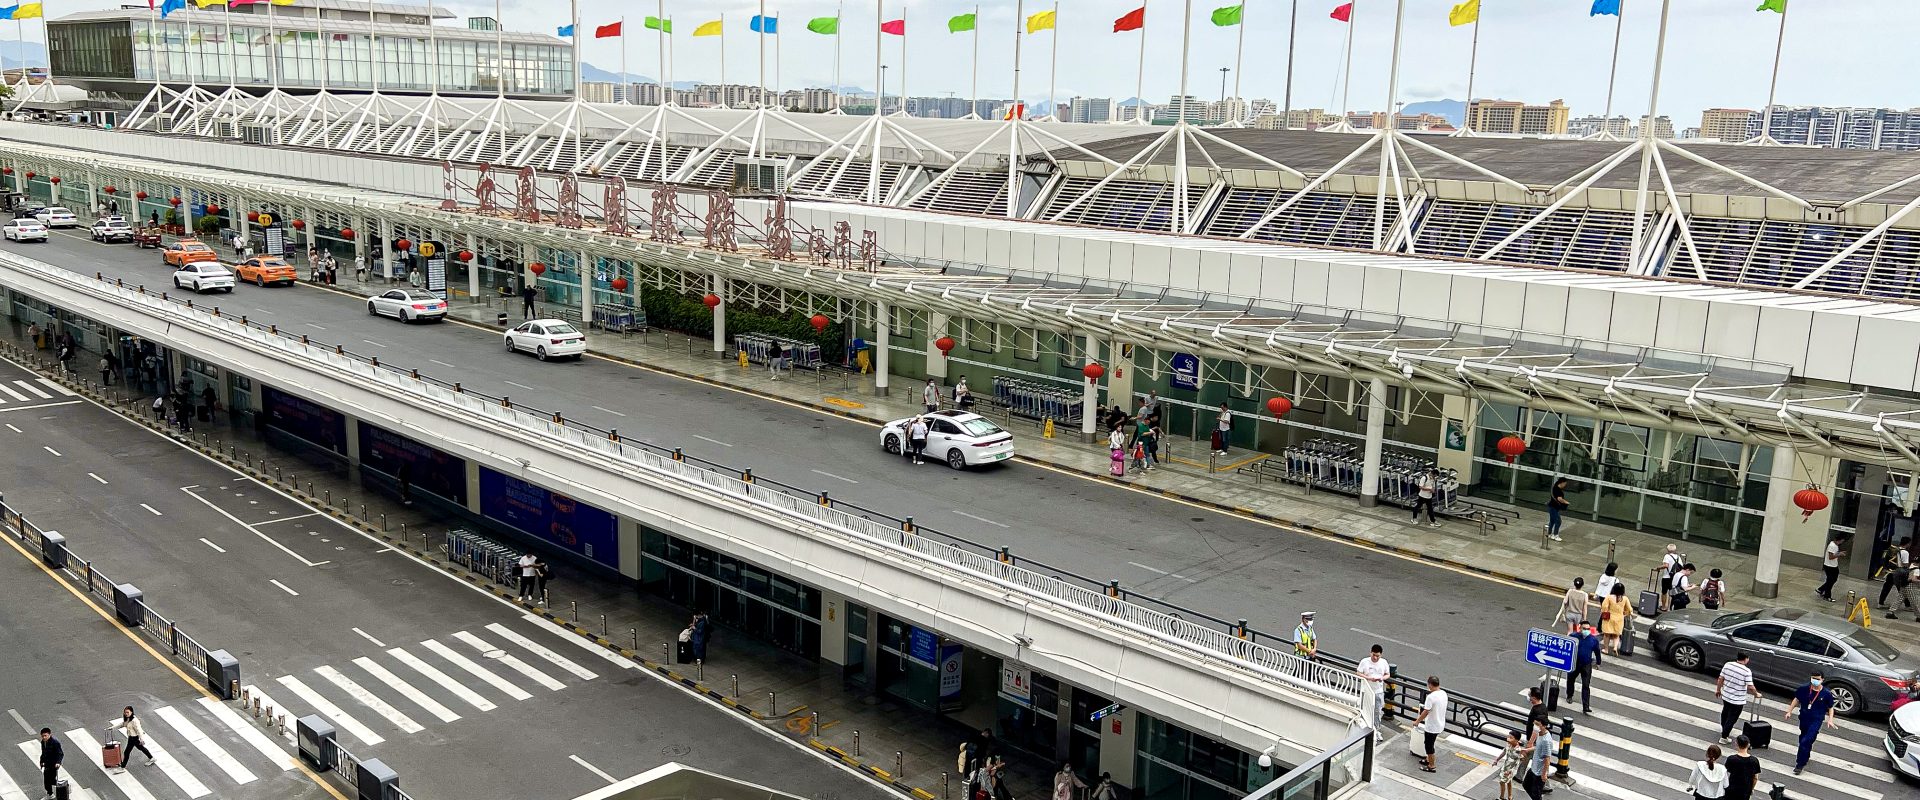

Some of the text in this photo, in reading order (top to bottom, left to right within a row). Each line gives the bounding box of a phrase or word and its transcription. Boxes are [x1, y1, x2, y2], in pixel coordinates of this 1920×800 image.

[423, 246, 433, 254] T1
[1531, 633, 1572, 651] 请绕行4号门
